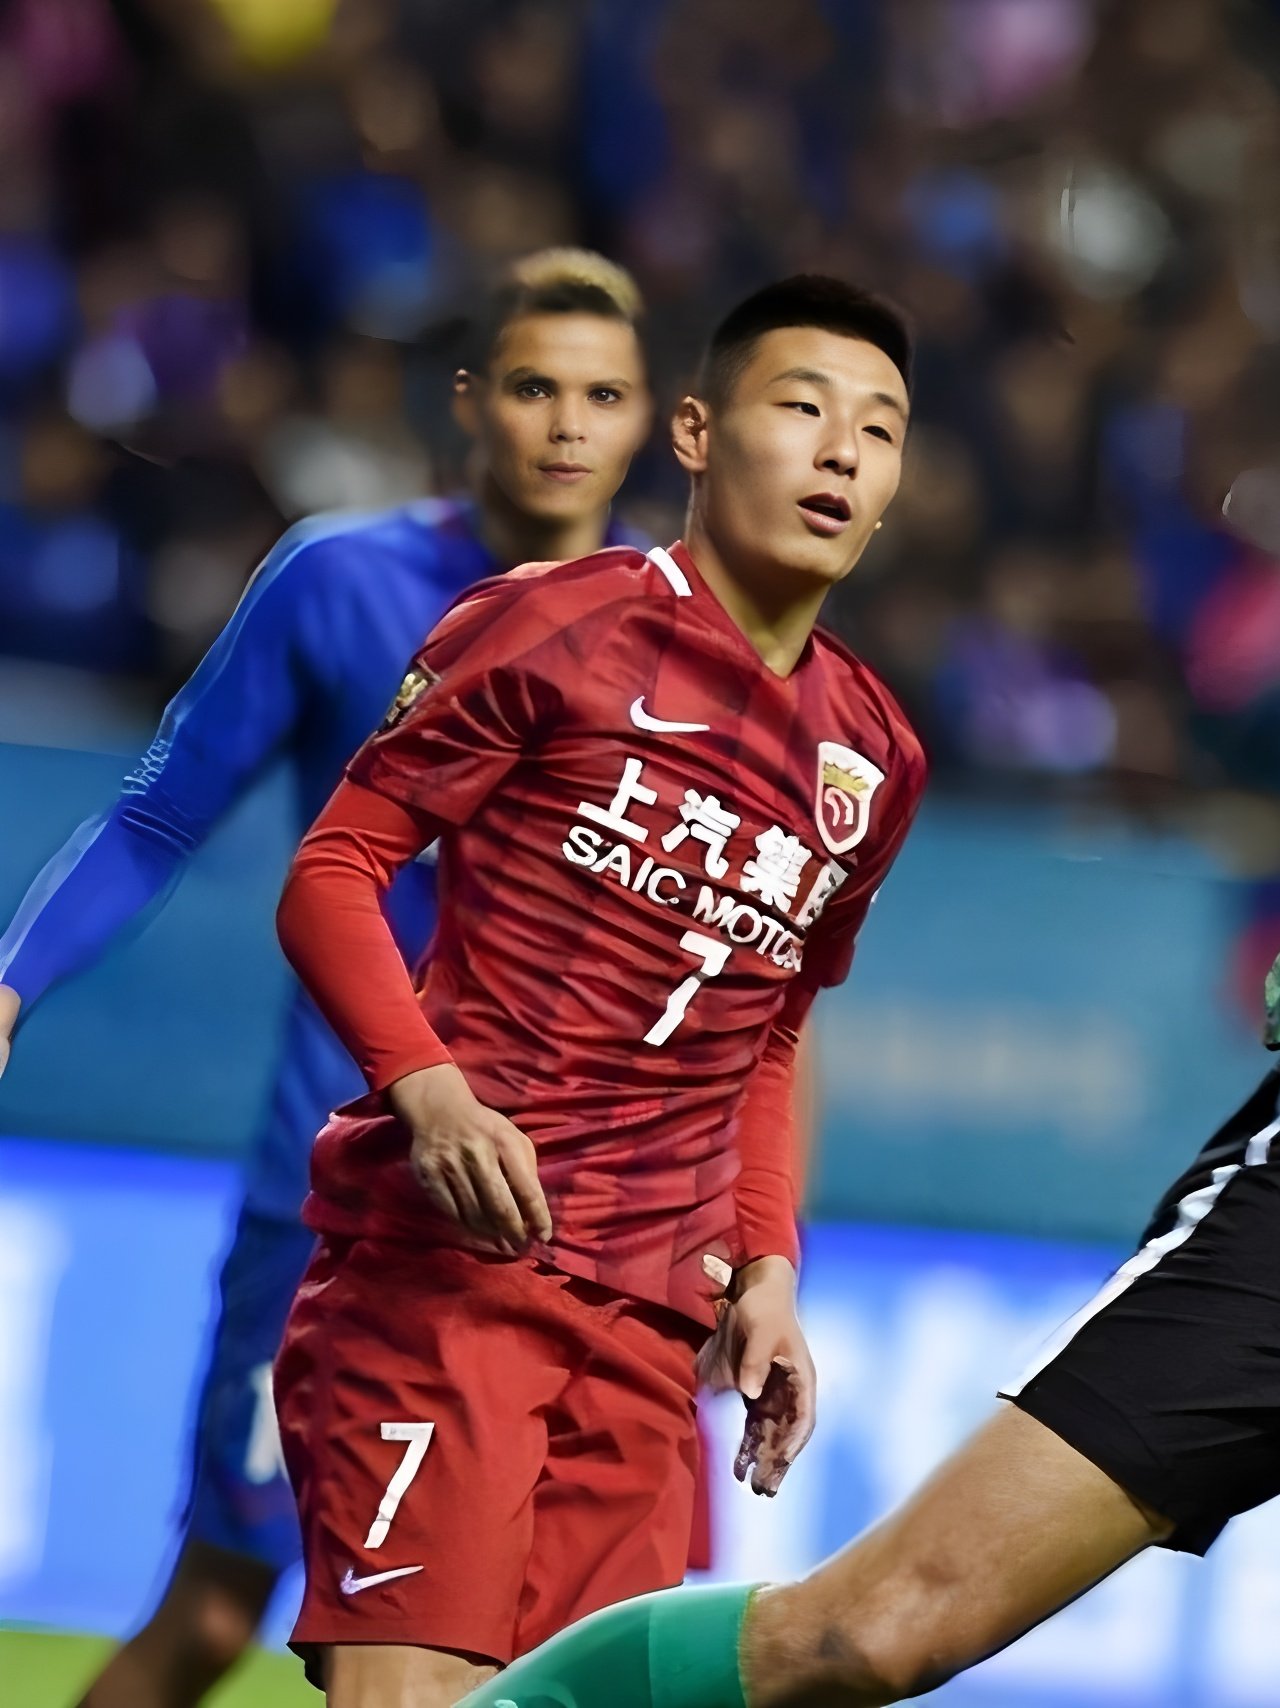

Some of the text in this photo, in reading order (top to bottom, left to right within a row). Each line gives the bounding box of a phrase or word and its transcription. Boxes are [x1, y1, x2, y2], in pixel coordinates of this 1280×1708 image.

[562, 825, 804, 973] SAIC MOTO
[643, 930, 733, 1047] 7
[363, 1422, 435, 1549] 7
